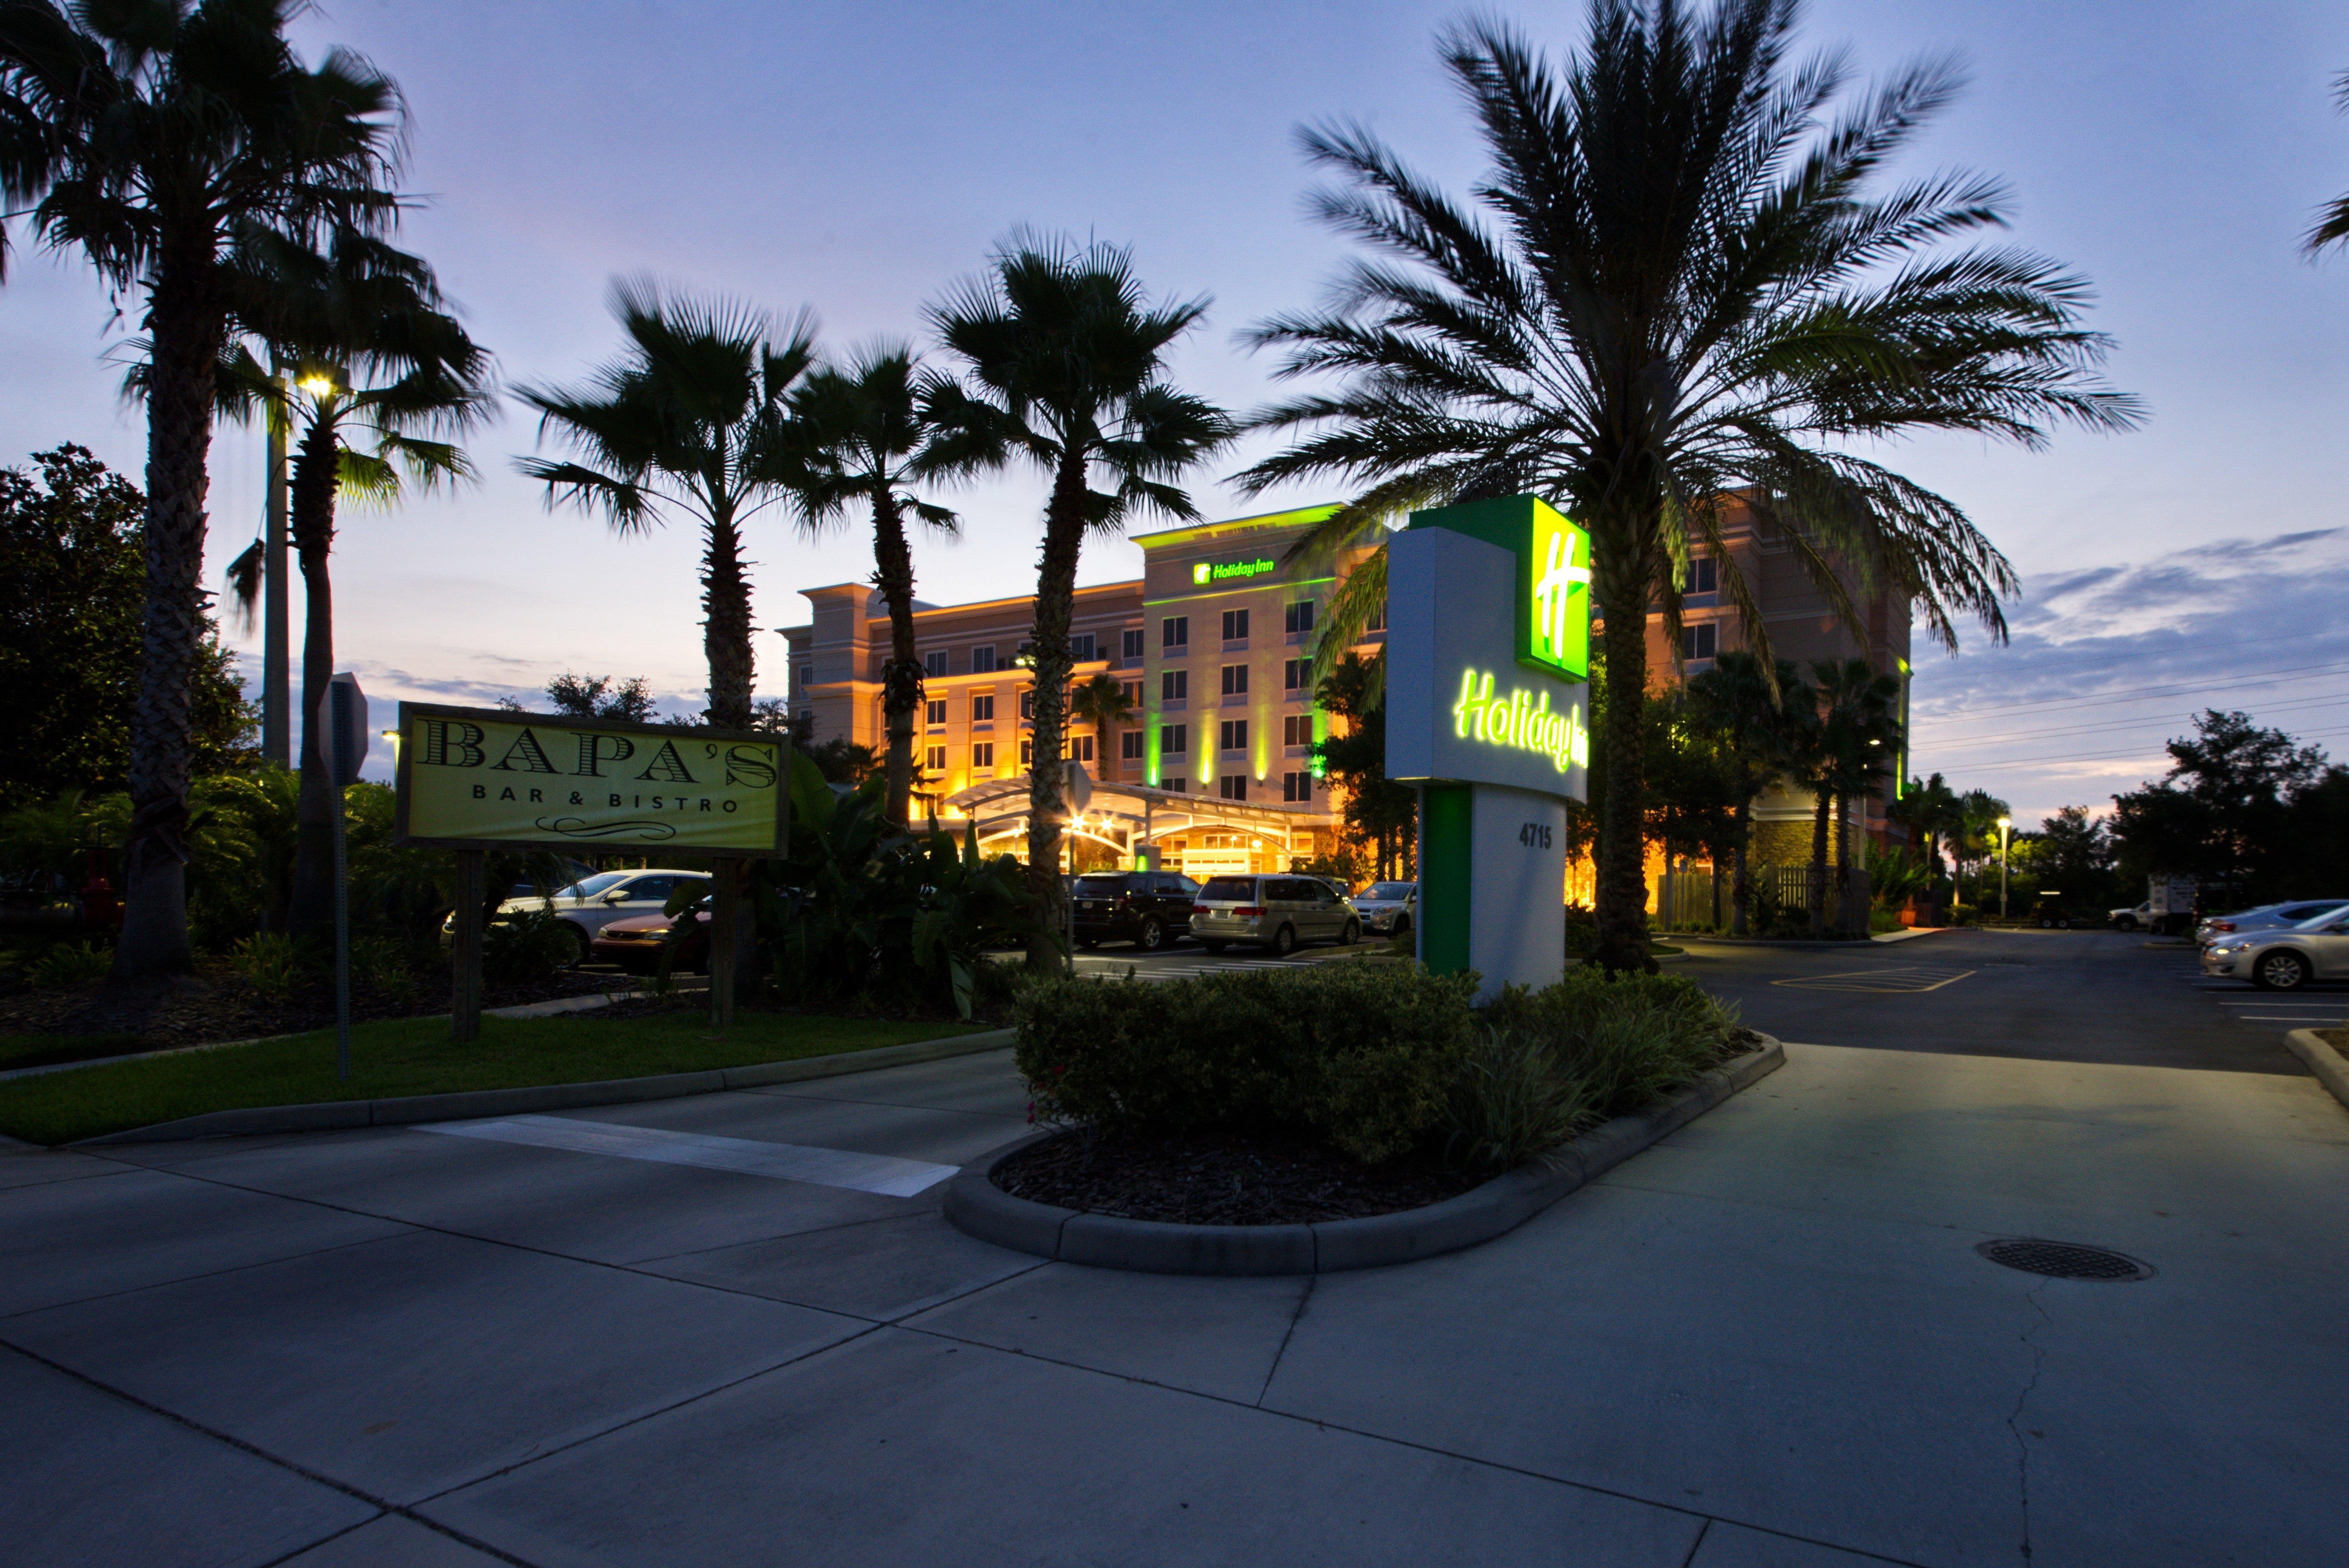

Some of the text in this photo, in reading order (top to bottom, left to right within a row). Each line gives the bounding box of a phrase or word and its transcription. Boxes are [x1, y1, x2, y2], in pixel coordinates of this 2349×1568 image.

[1213, 559, 1274, 579] Holiday Inn
[1455, 670, 1571, 772] Holiday
[415, 718, 778, 789] BAPA'S
[472, 785, 738, 814] BAR & BISTRO
[1519, 823, 1552, 849] 4715
